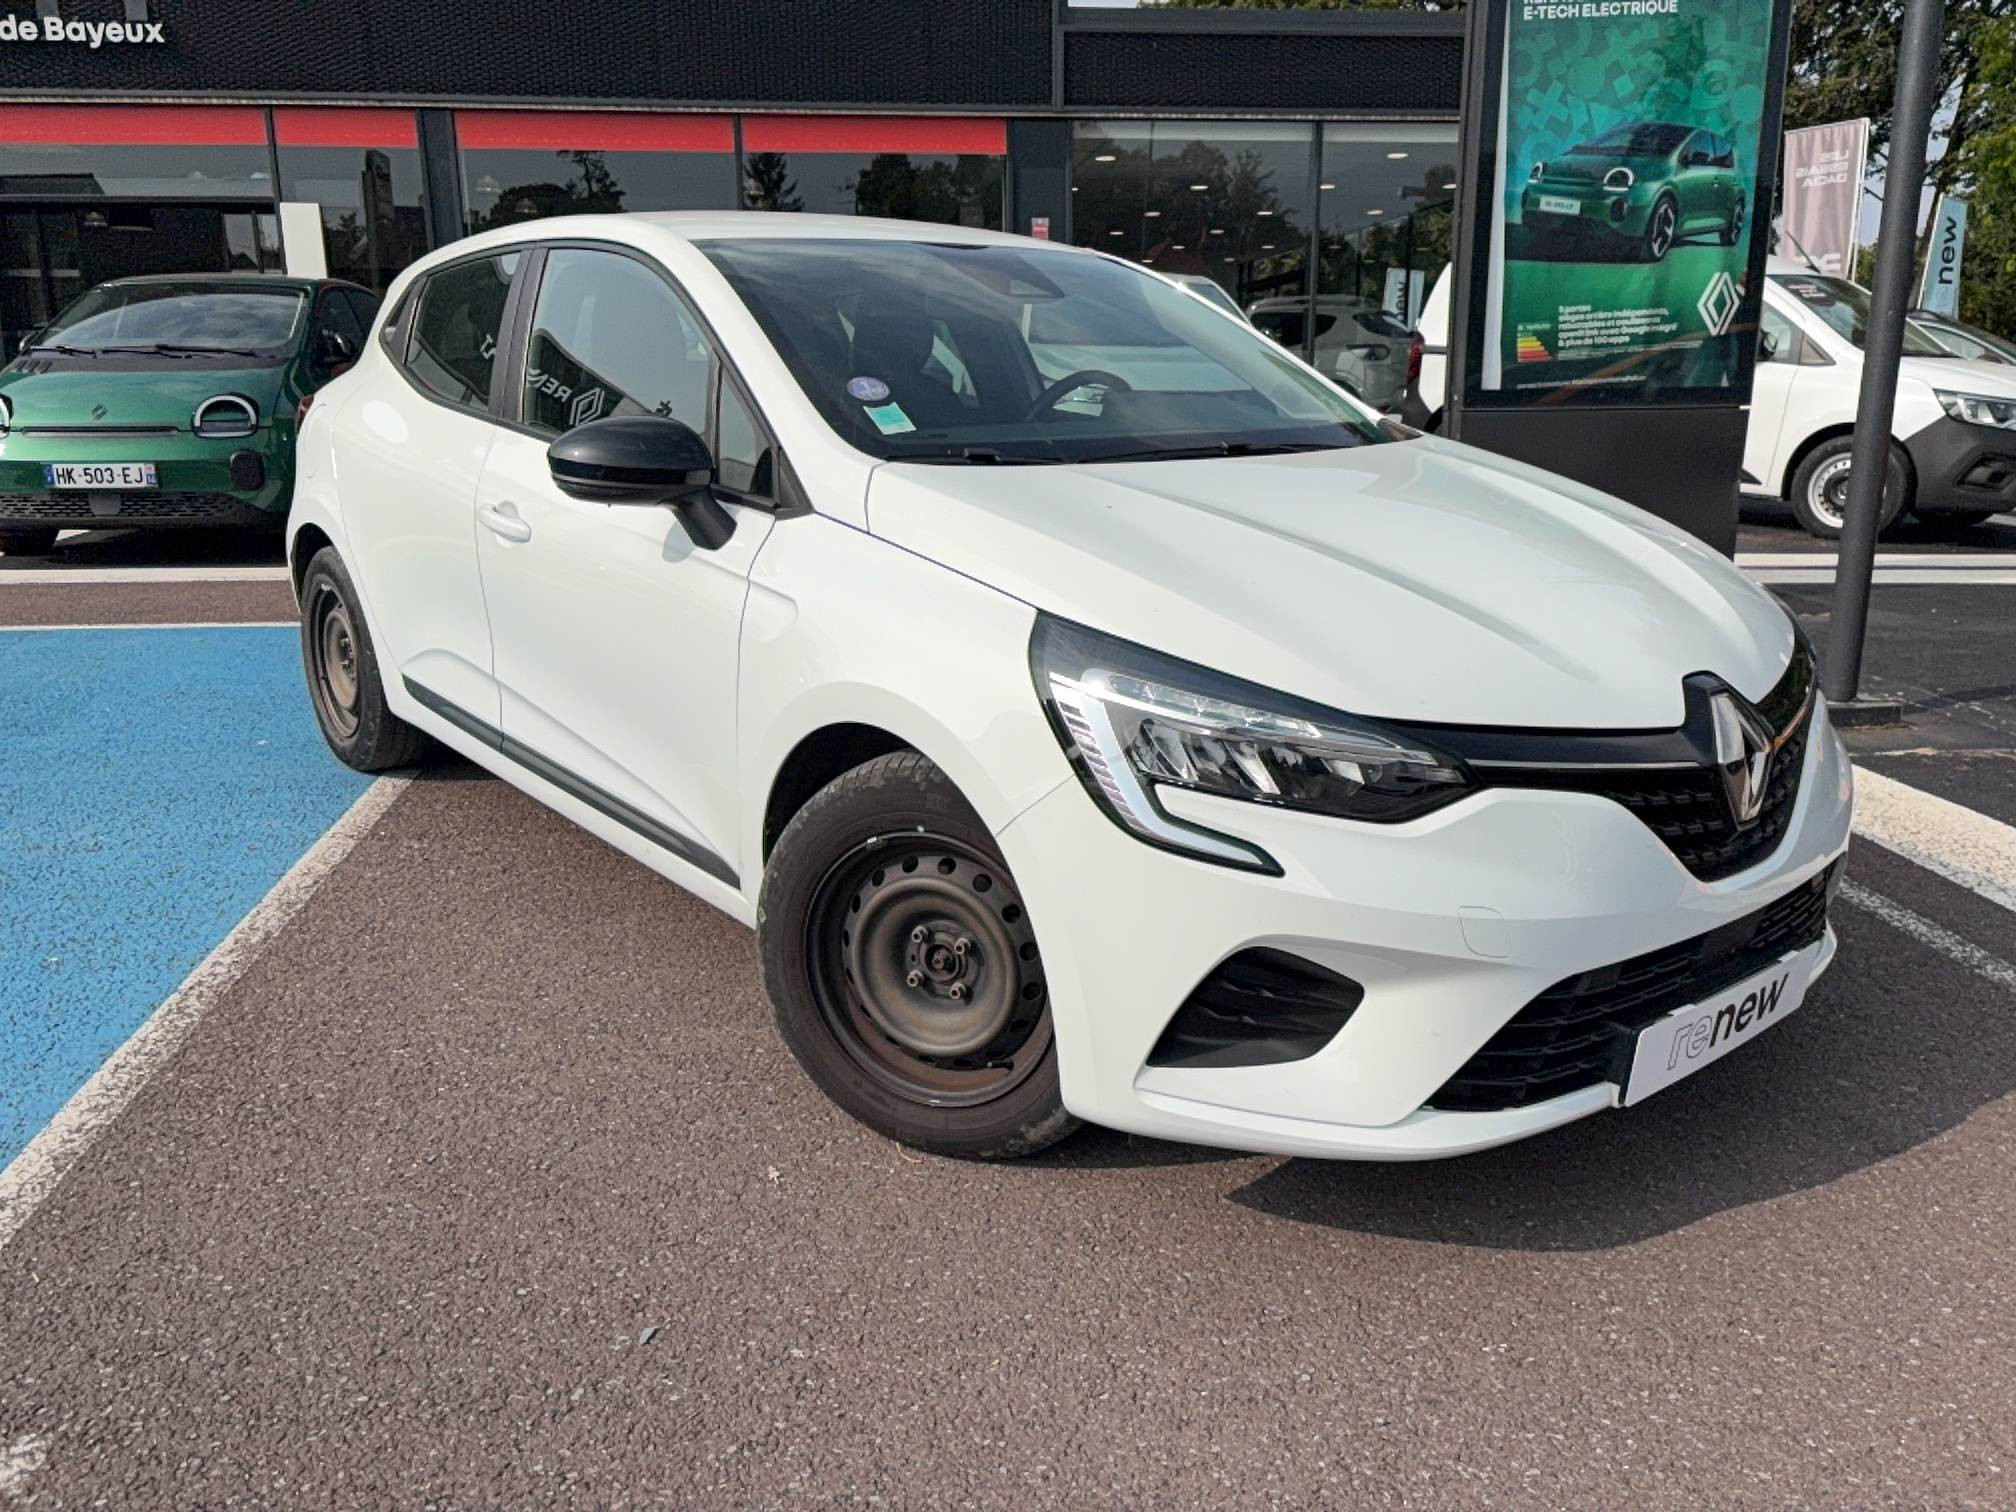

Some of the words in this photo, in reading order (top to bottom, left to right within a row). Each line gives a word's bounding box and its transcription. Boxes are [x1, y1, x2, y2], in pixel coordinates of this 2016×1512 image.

[1523, 3, 1579, 21] E-TECH
[1582, 0, 1678, 17] ELECTRIQUE
[0, 14, 38, 41] de
[43, 16, 165, 48] Bayeux
[55, 467, 143, 486] HK-503-EJ
[1667, 972, 1790, 1071] renew
